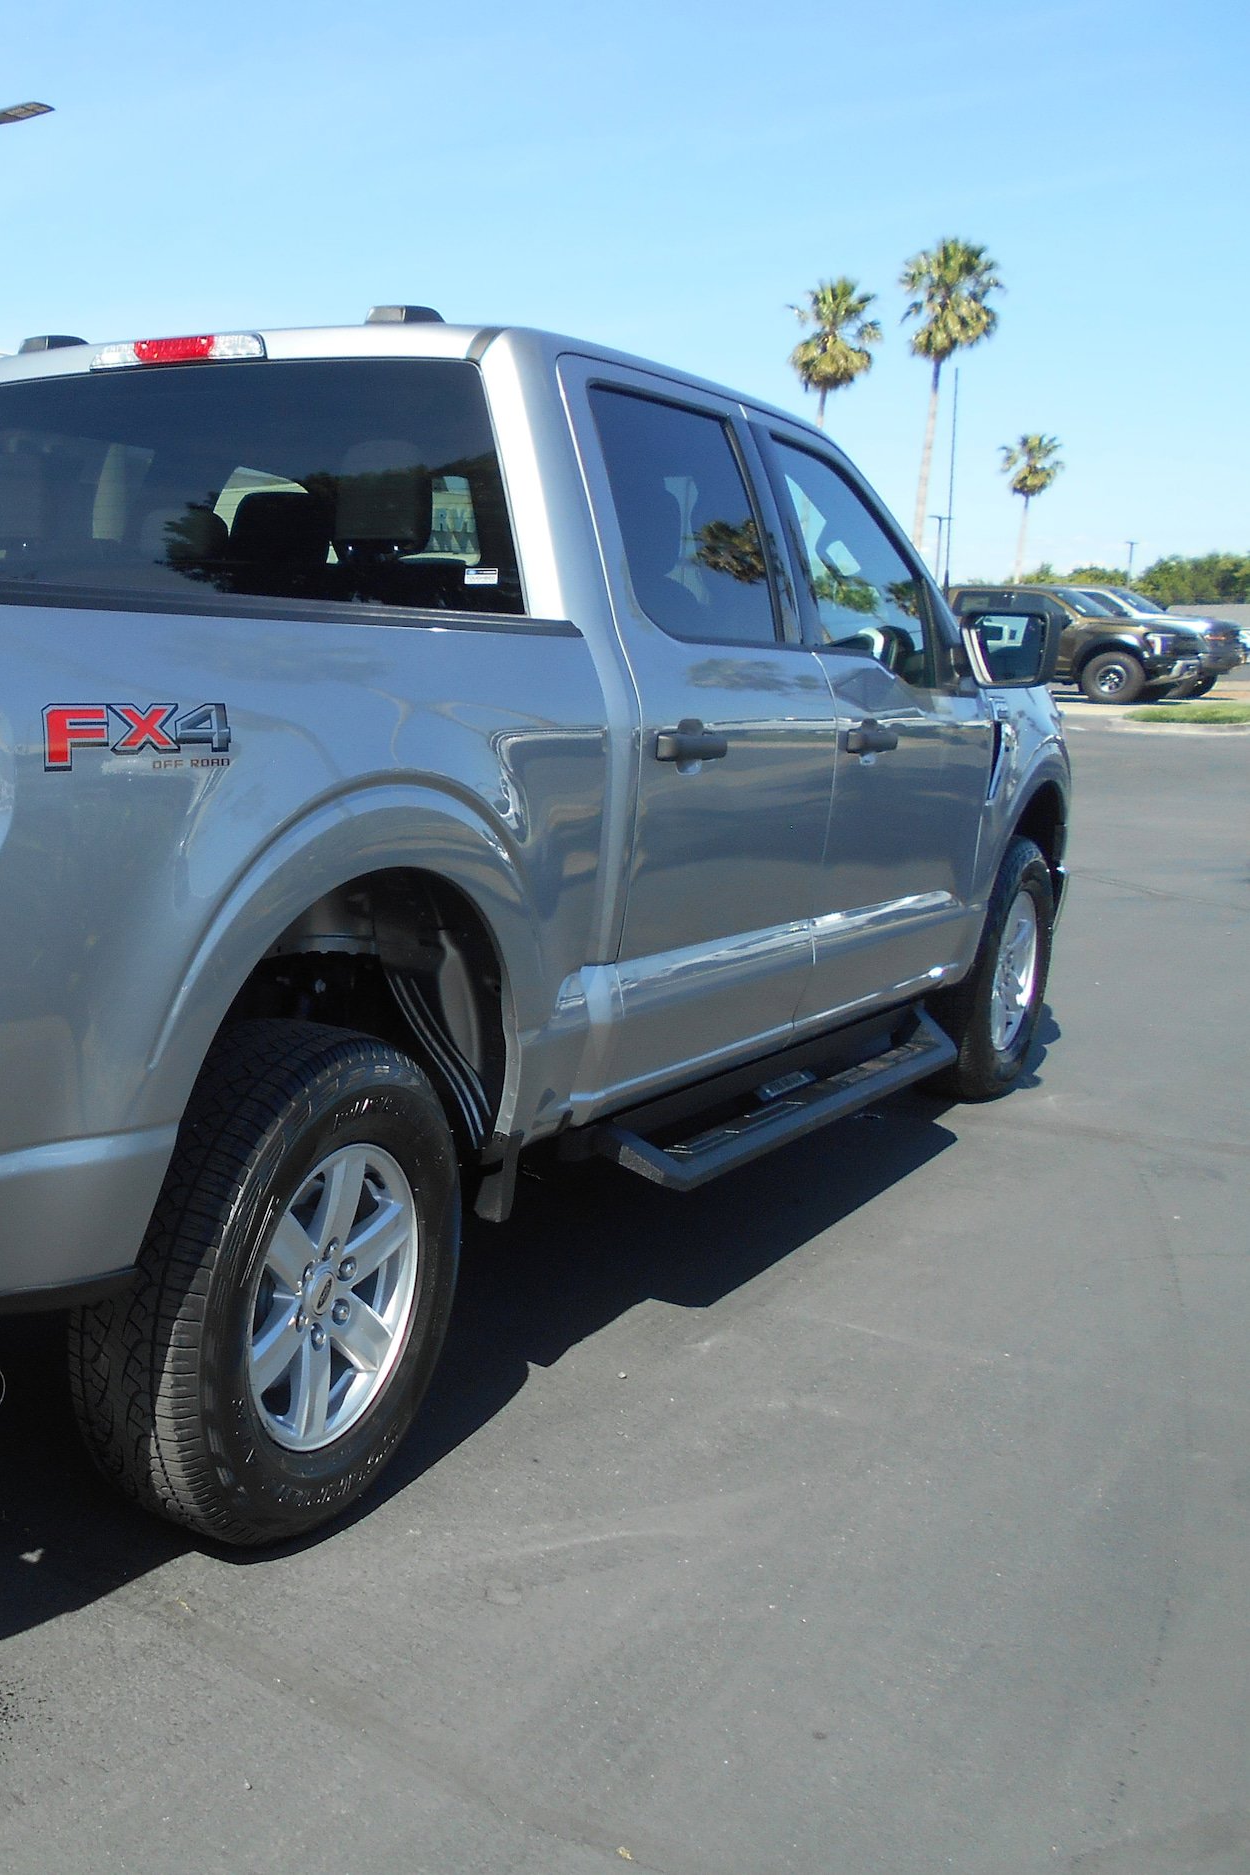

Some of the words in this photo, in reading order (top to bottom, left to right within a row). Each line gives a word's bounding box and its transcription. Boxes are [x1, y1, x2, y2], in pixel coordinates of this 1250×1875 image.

[41, 703, 232, 772] FX4
[152, 760, 184, 769] OFF
[190, 758, 231, 768] ROAD
